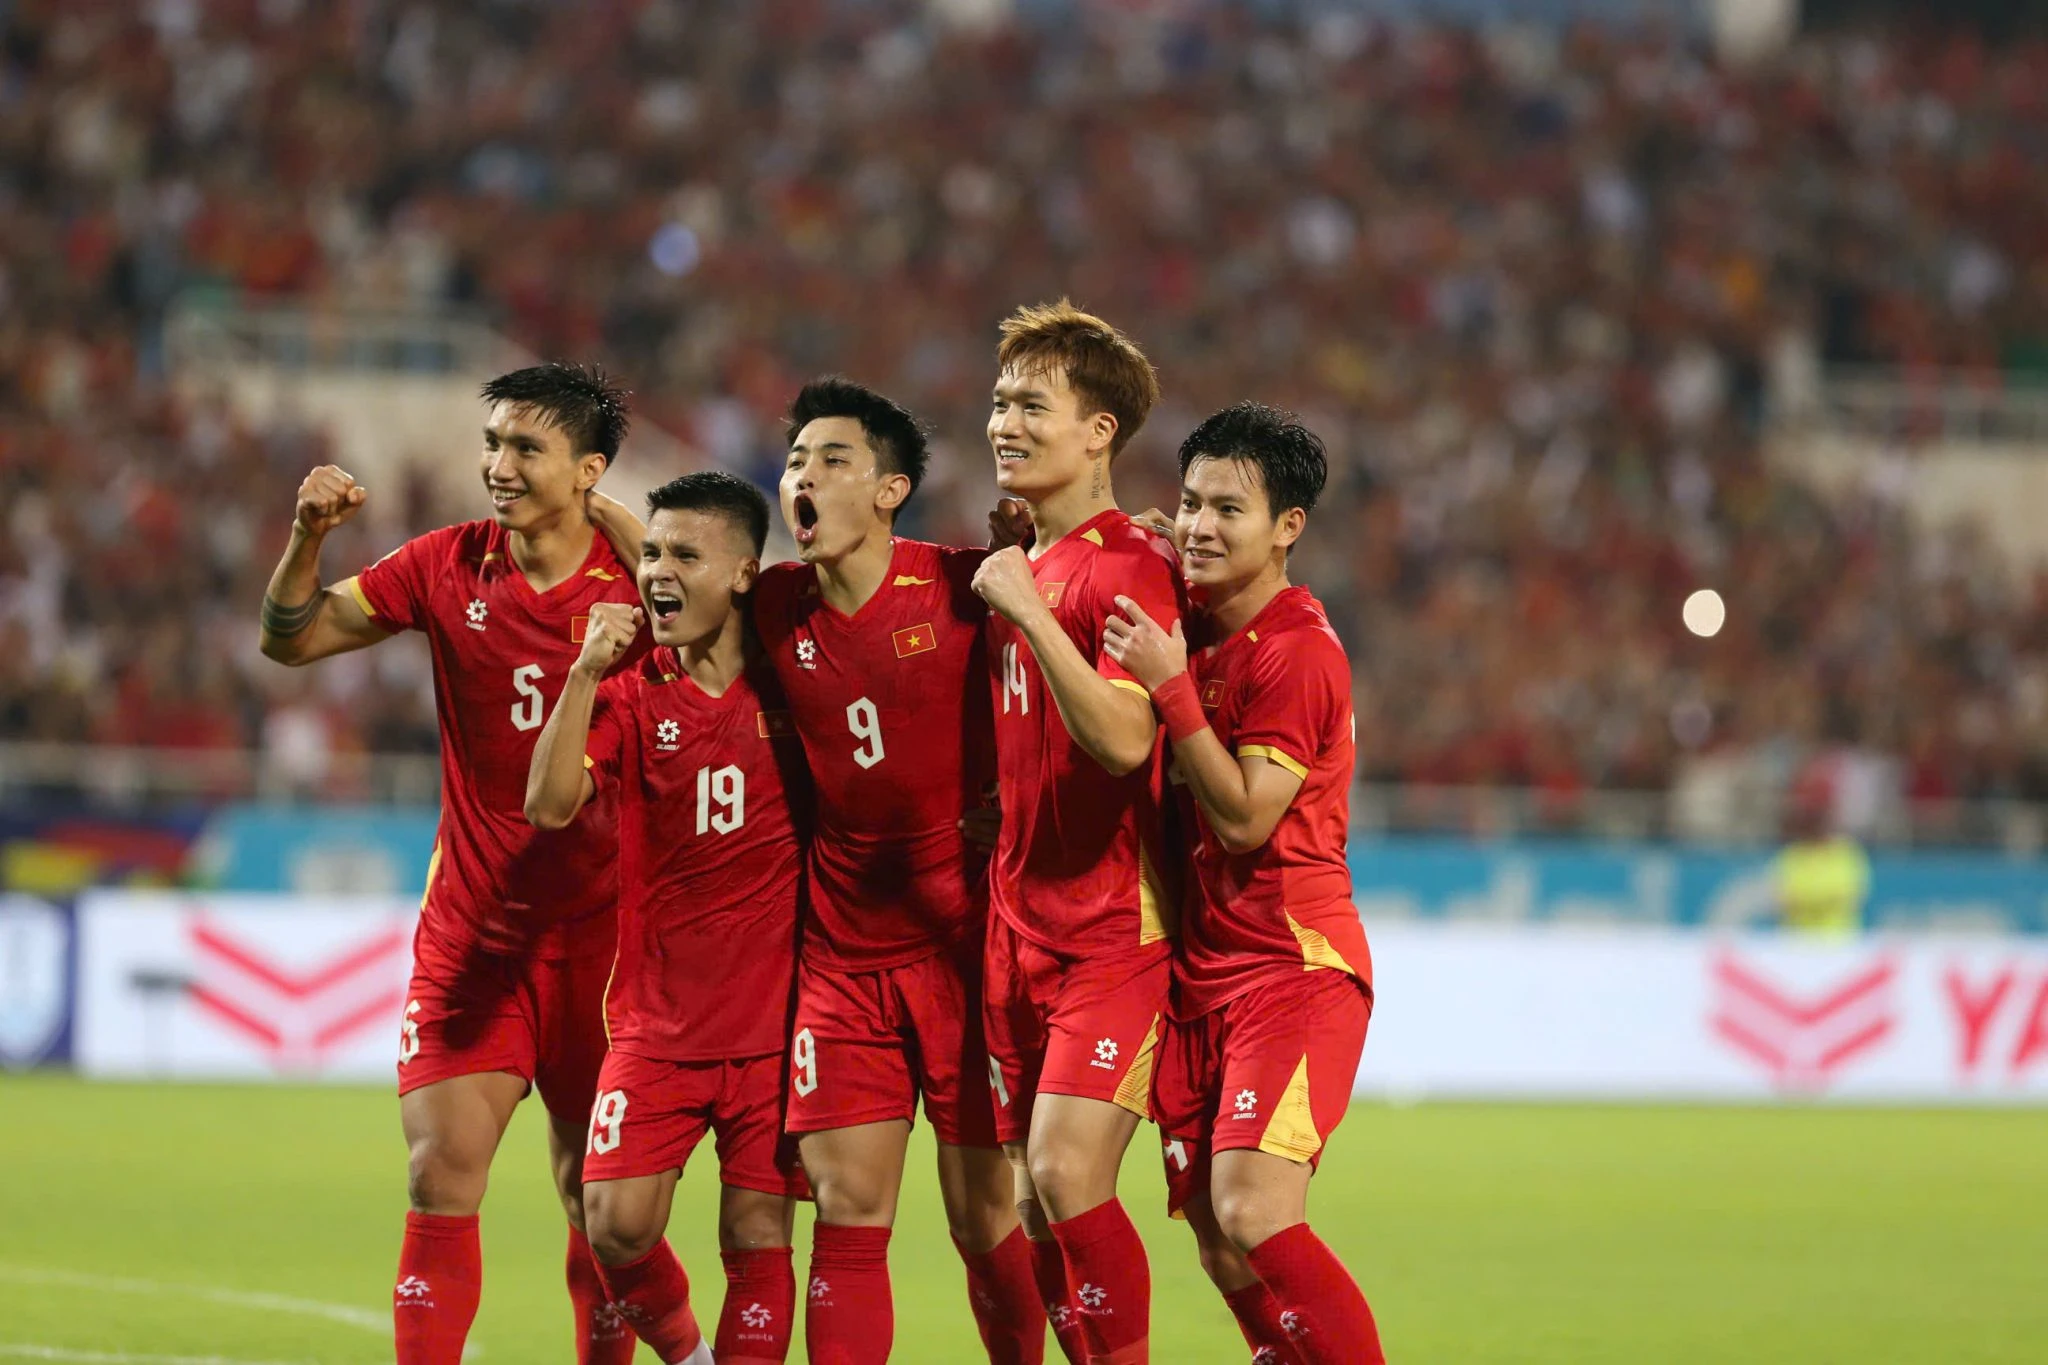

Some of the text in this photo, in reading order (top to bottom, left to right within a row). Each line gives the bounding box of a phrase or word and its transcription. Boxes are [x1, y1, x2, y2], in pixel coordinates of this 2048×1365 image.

[511, 663, 545, 732] 5
[1003, 642, 1029, 716] 14
[846, 696, 885, 770] 9
[696, 764, 744, 836] 19
[400, 999, 421, 1065] 5
[794, 1027, 818, 1098] 9
[586, 1089, 628, 1156] 19
